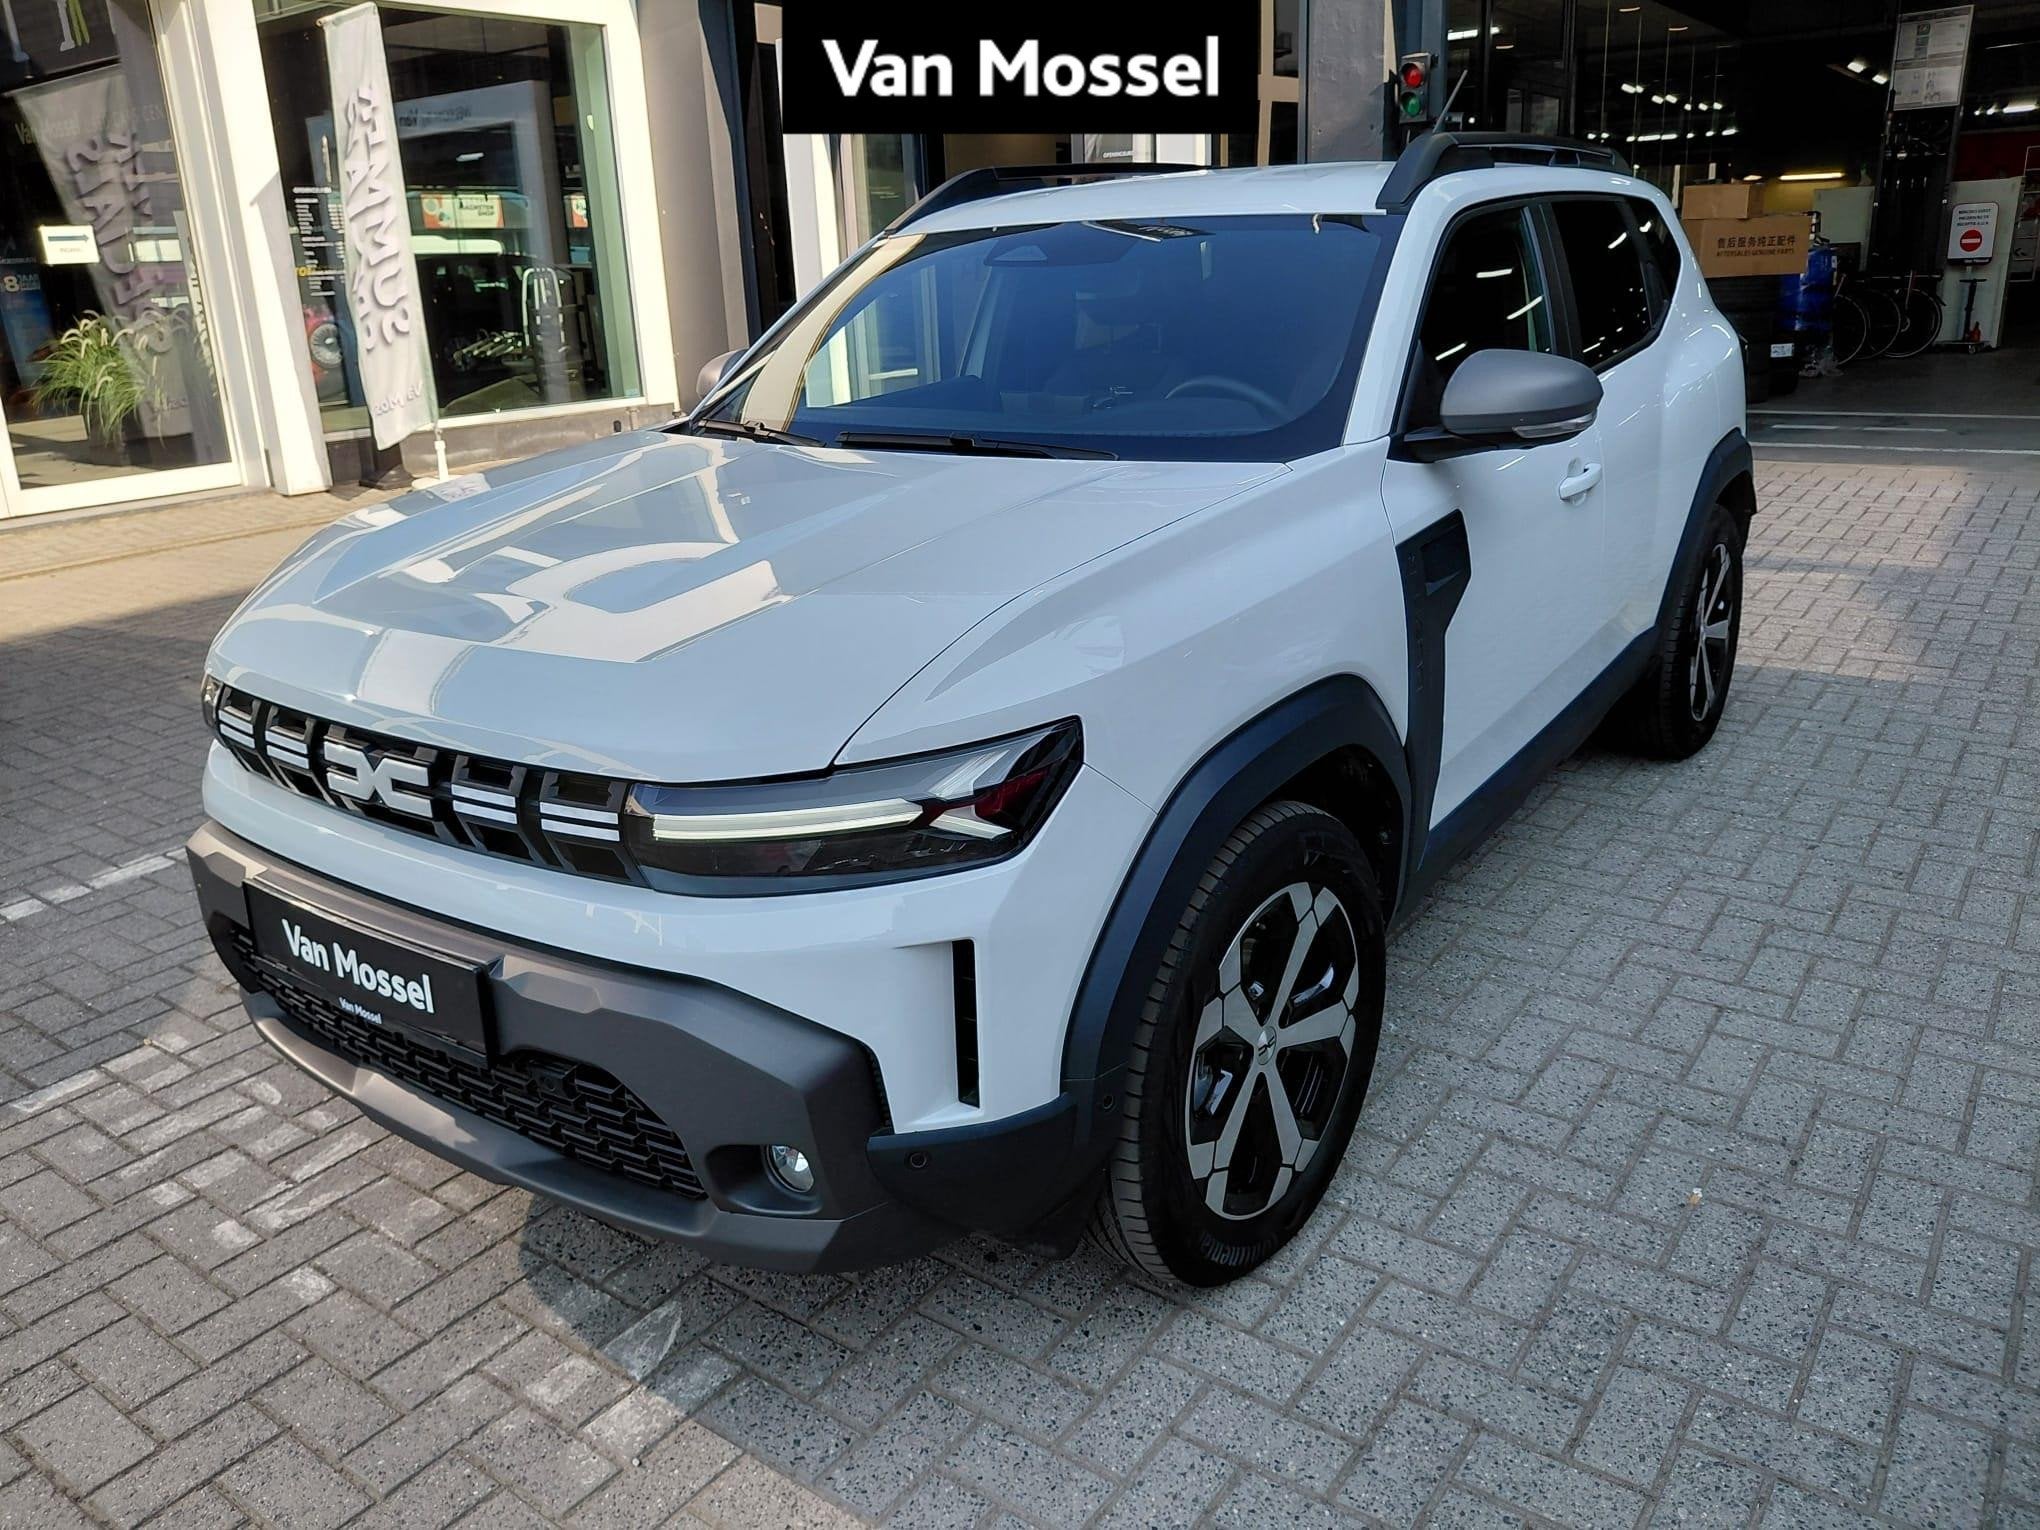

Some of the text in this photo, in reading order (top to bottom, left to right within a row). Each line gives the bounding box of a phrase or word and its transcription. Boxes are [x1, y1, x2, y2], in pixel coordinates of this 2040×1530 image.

[281, 918, 435, 1014] Van Mossel
[339, 996, 383, 1025] Van Mossel
